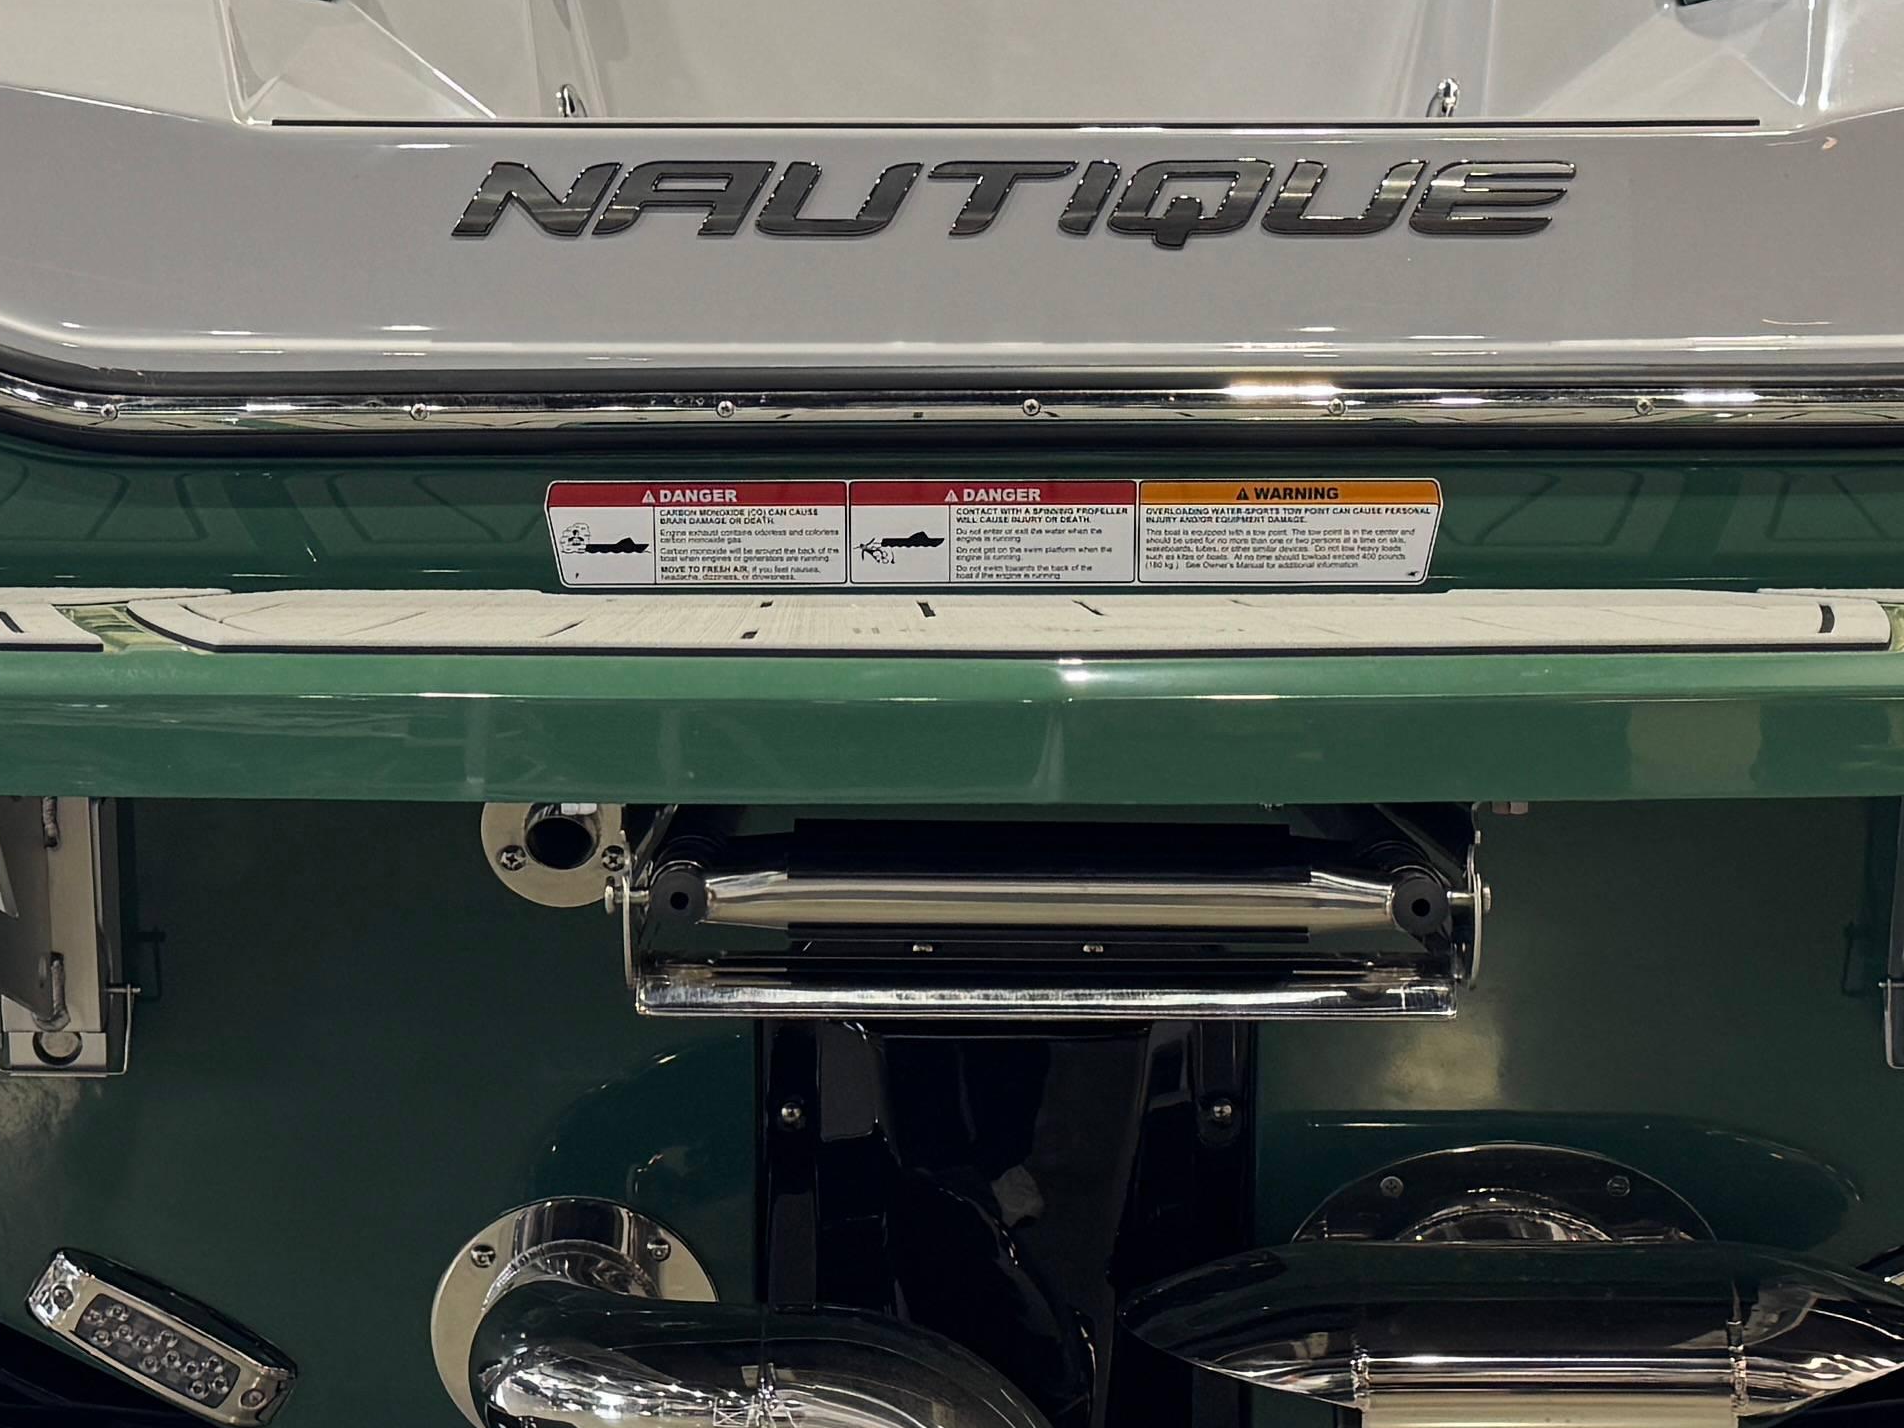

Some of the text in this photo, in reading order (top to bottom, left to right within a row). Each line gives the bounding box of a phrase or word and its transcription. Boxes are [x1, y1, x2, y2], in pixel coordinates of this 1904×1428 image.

[450, 157, 1577, 249] NAUTIQUE
[660, 489, 737, 503] DANGER
[963, 488, 1041, 502] DANGER
[1254, 487, 1339, 500] WARNING
